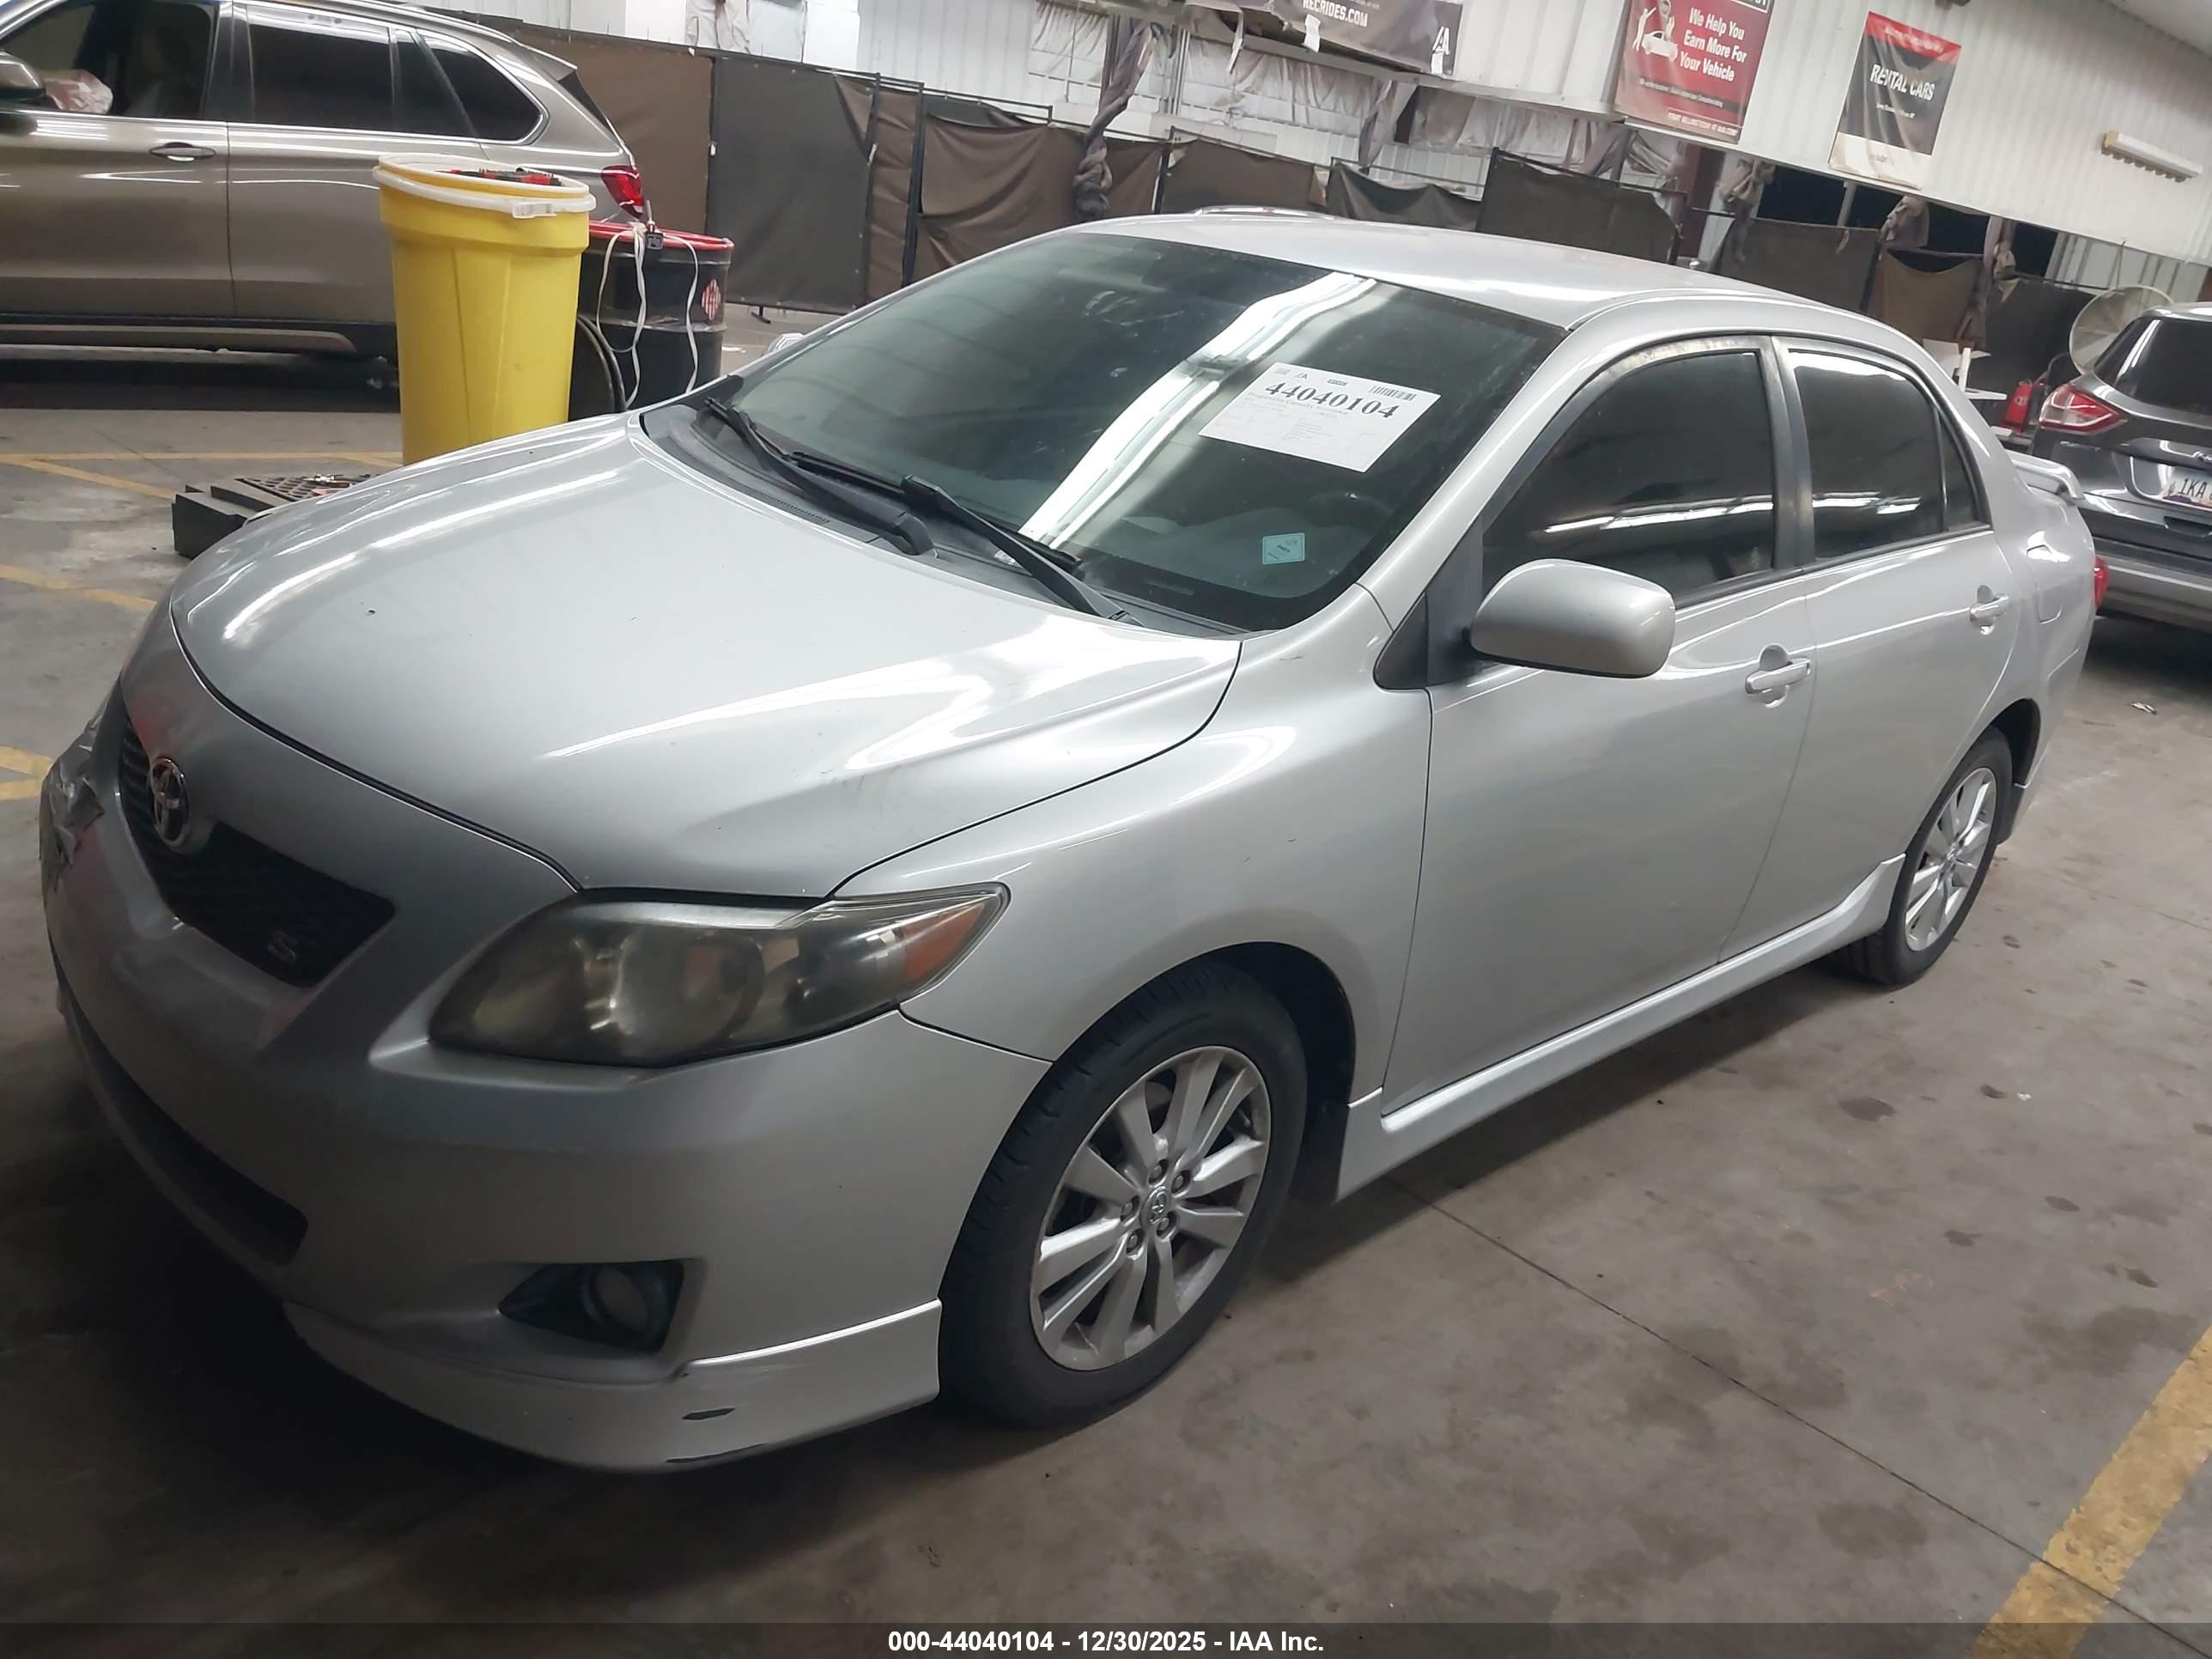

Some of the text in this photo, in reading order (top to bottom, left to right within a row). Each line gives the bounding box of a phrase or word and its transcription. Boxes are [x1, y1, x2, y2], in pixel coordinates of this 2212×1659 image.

[1689, 8, 1745, 40] We Help You
[1683, 30, 1747, 64] Earn More For
[1680, 52, 1735, 82] Your Vehicle
[1869, 64, 1935, 100] RENTAL CARS
[1264, 382, 1401, 419] 44040104
